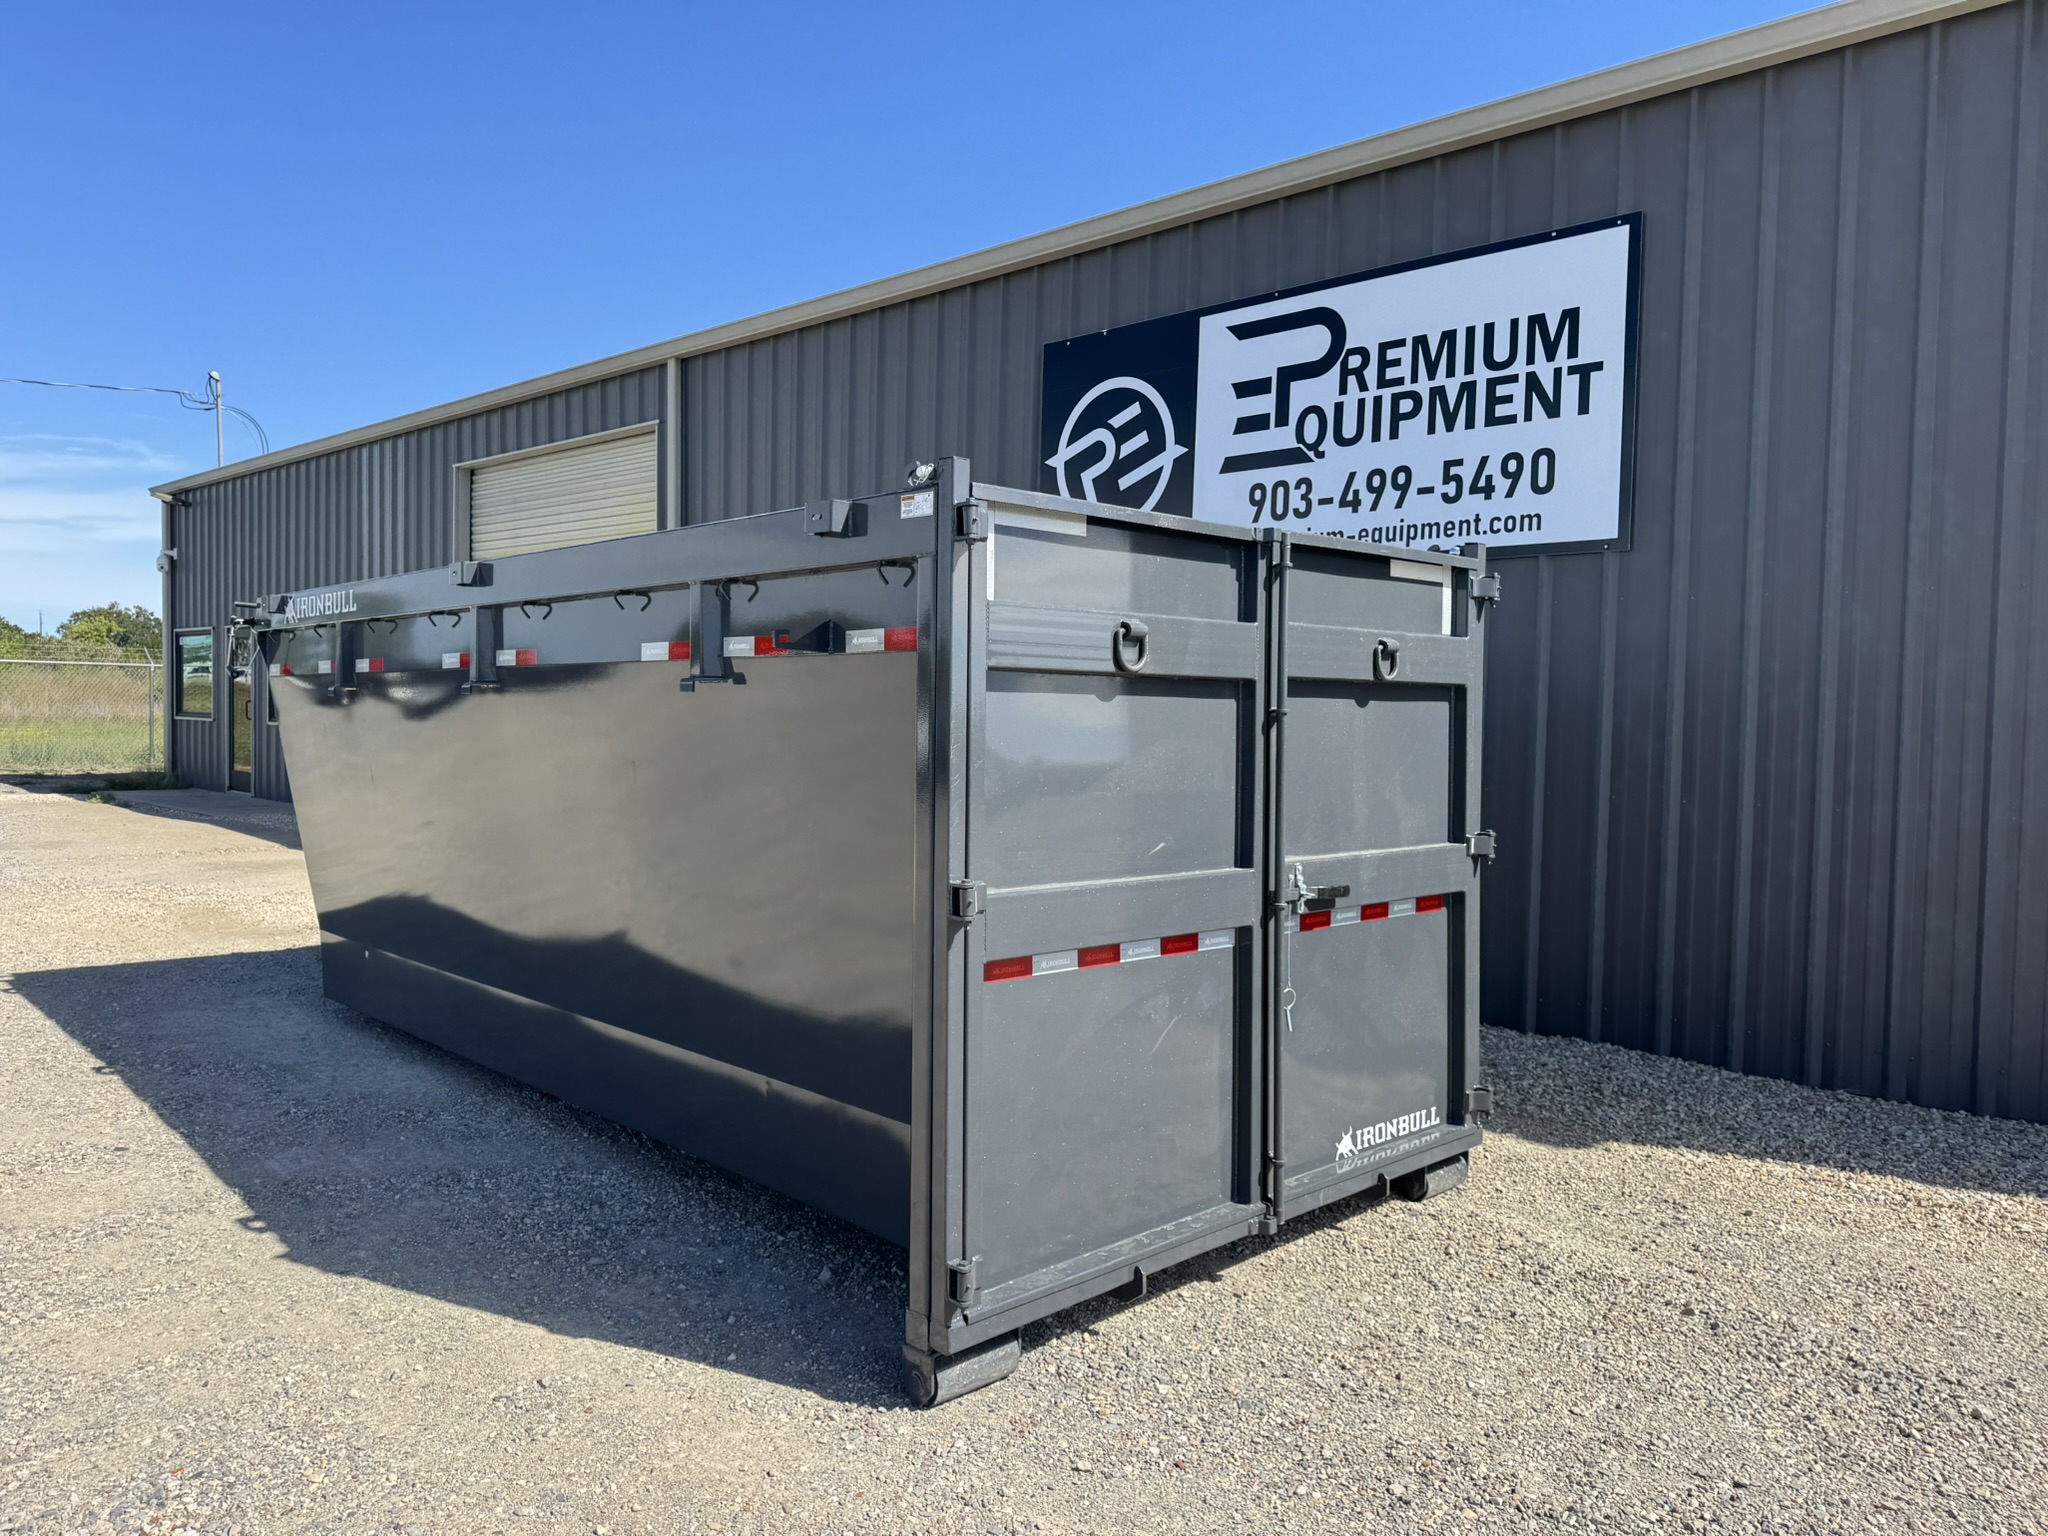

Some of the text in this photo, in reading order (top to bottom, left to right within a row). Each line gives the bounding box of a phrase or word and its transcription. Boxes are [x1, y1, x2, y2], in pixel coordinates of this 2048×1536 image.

[1226, 306, 1581, 428] PREMIUM
[1248, 447, 1556, 523] 903-499-5490
[296, 589, 357, 619] IRONBULL
[1355, 1106, 1440, 1151] IRONBULL
